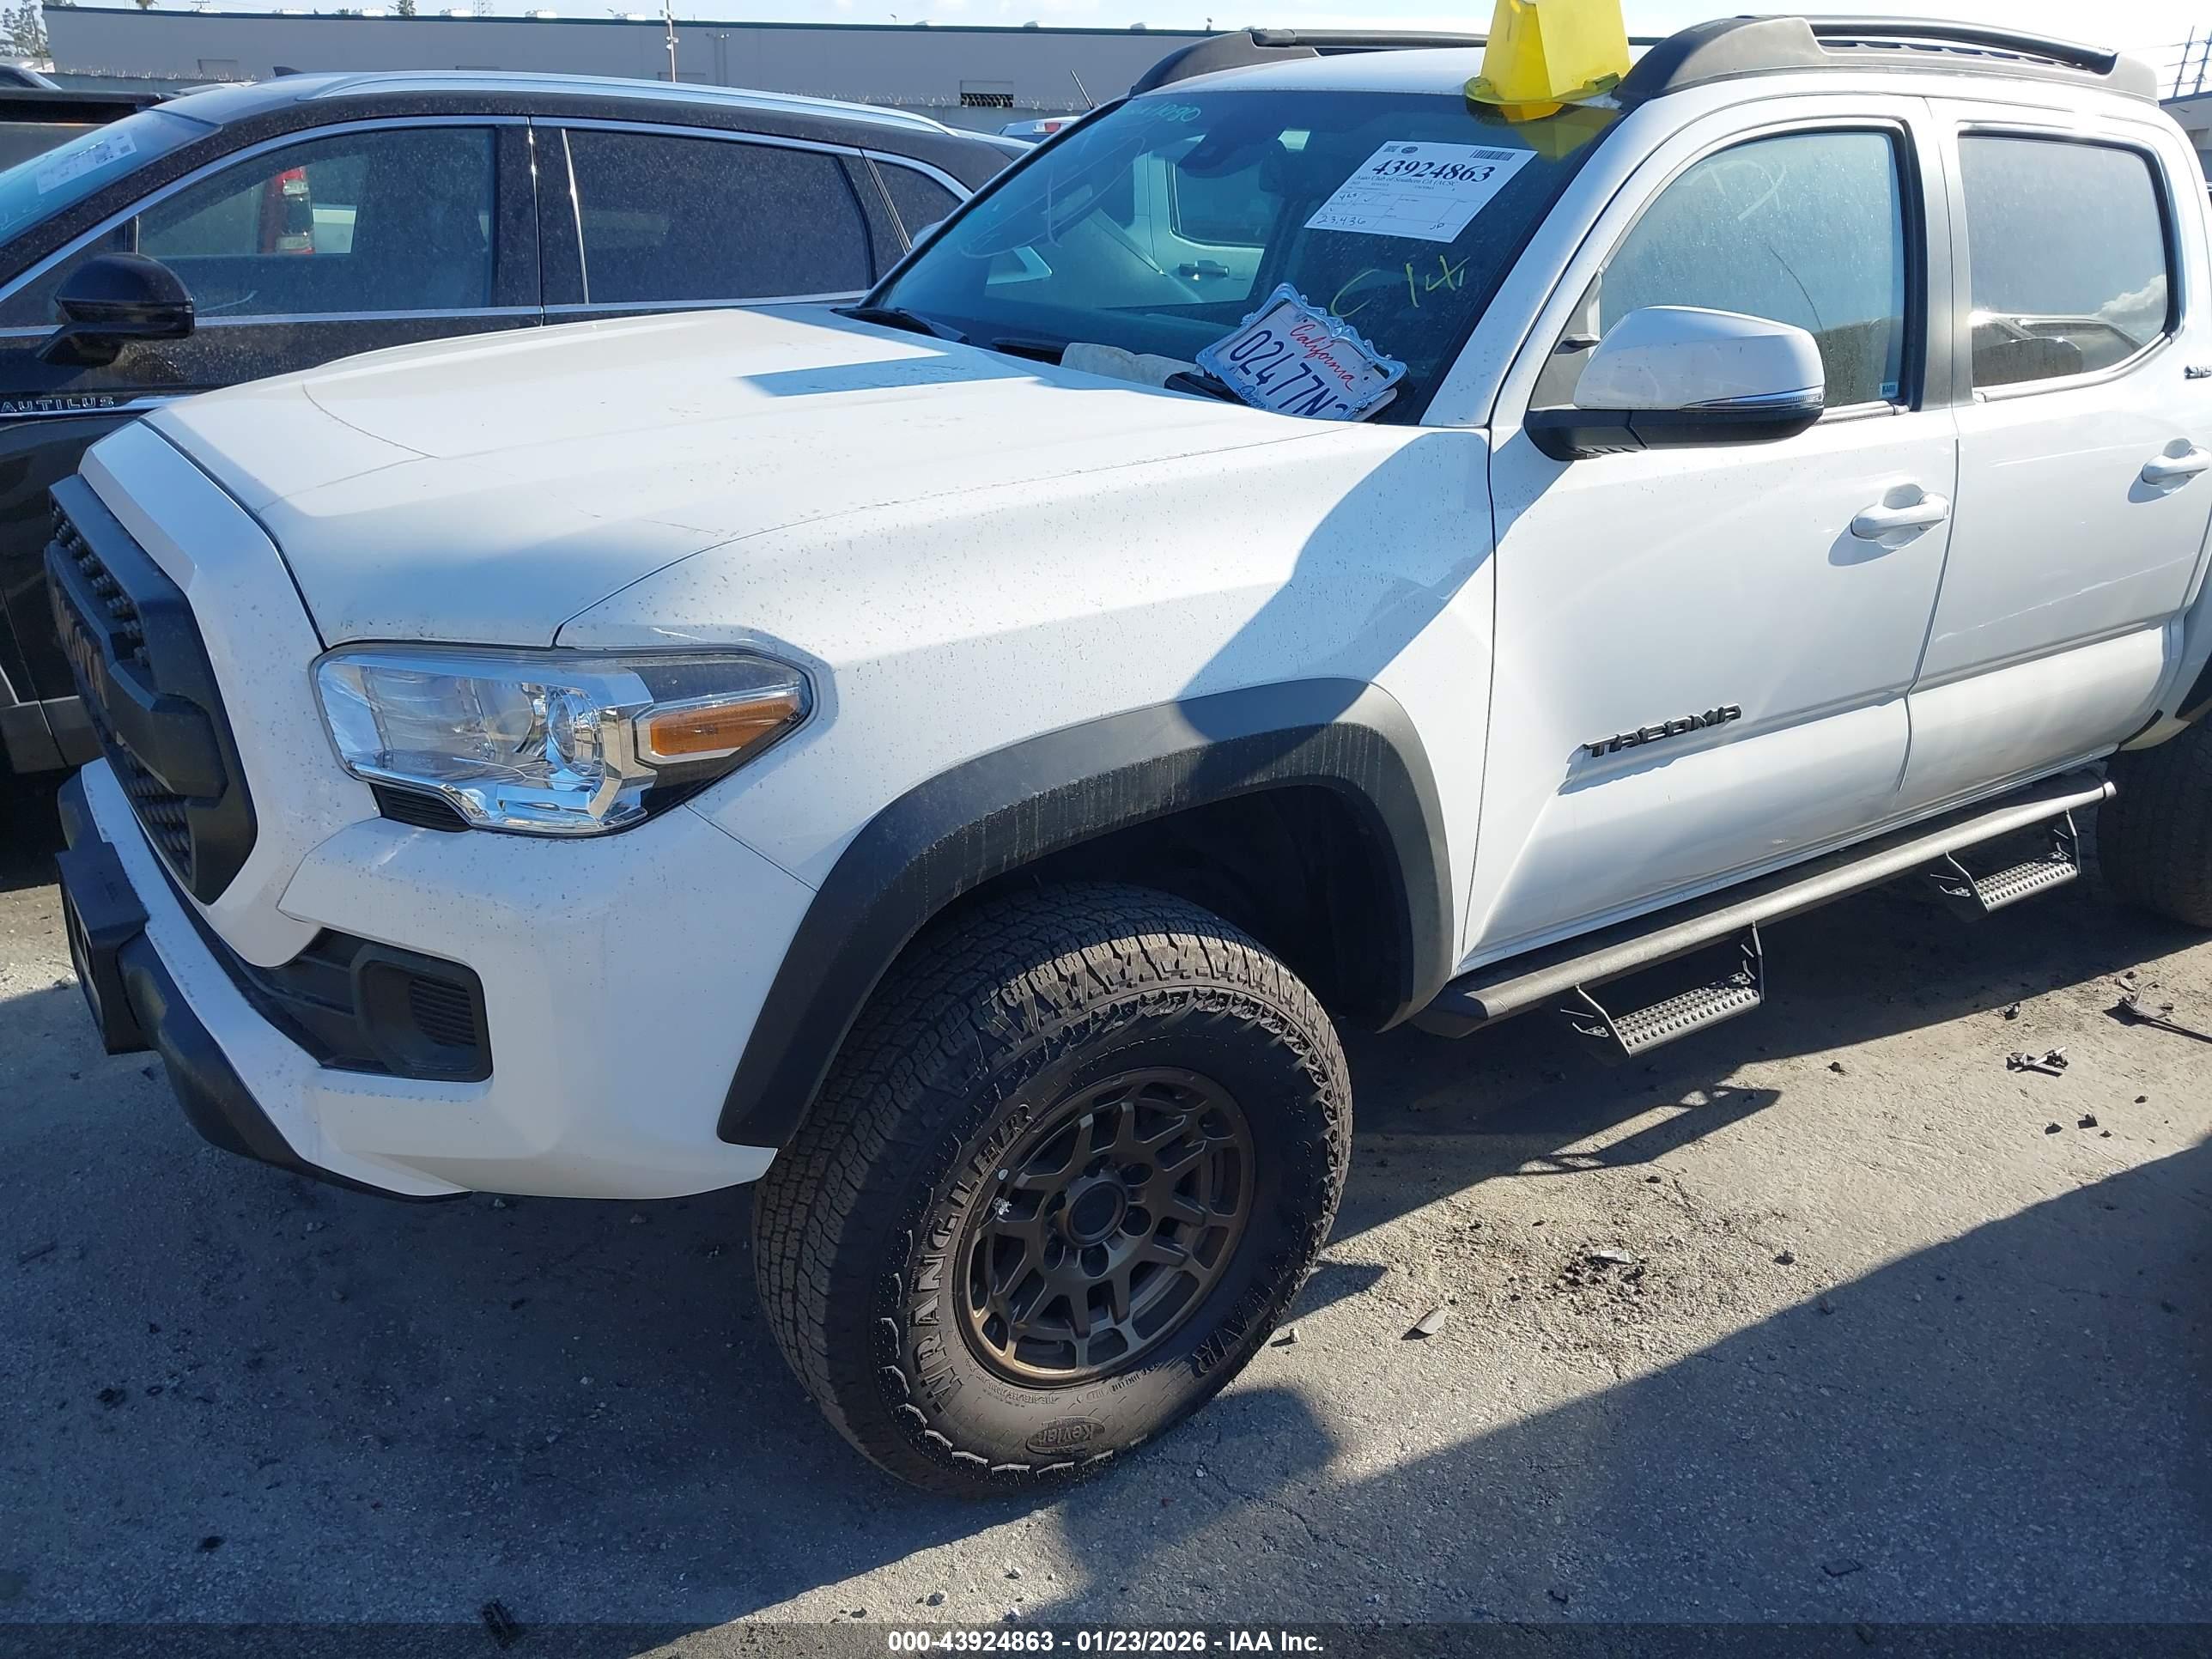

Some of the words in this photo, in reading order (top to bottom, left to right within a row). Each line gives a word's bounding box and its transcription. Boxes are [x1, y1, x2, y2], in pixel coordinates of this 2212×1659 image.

[1372, 158, 1497, 183] 43924863
[1290, 323, 1357, 392] California
[1583, 703, 1742, 758] TACOMA
[912, 1103, 1035, 1415] WRANGLER
